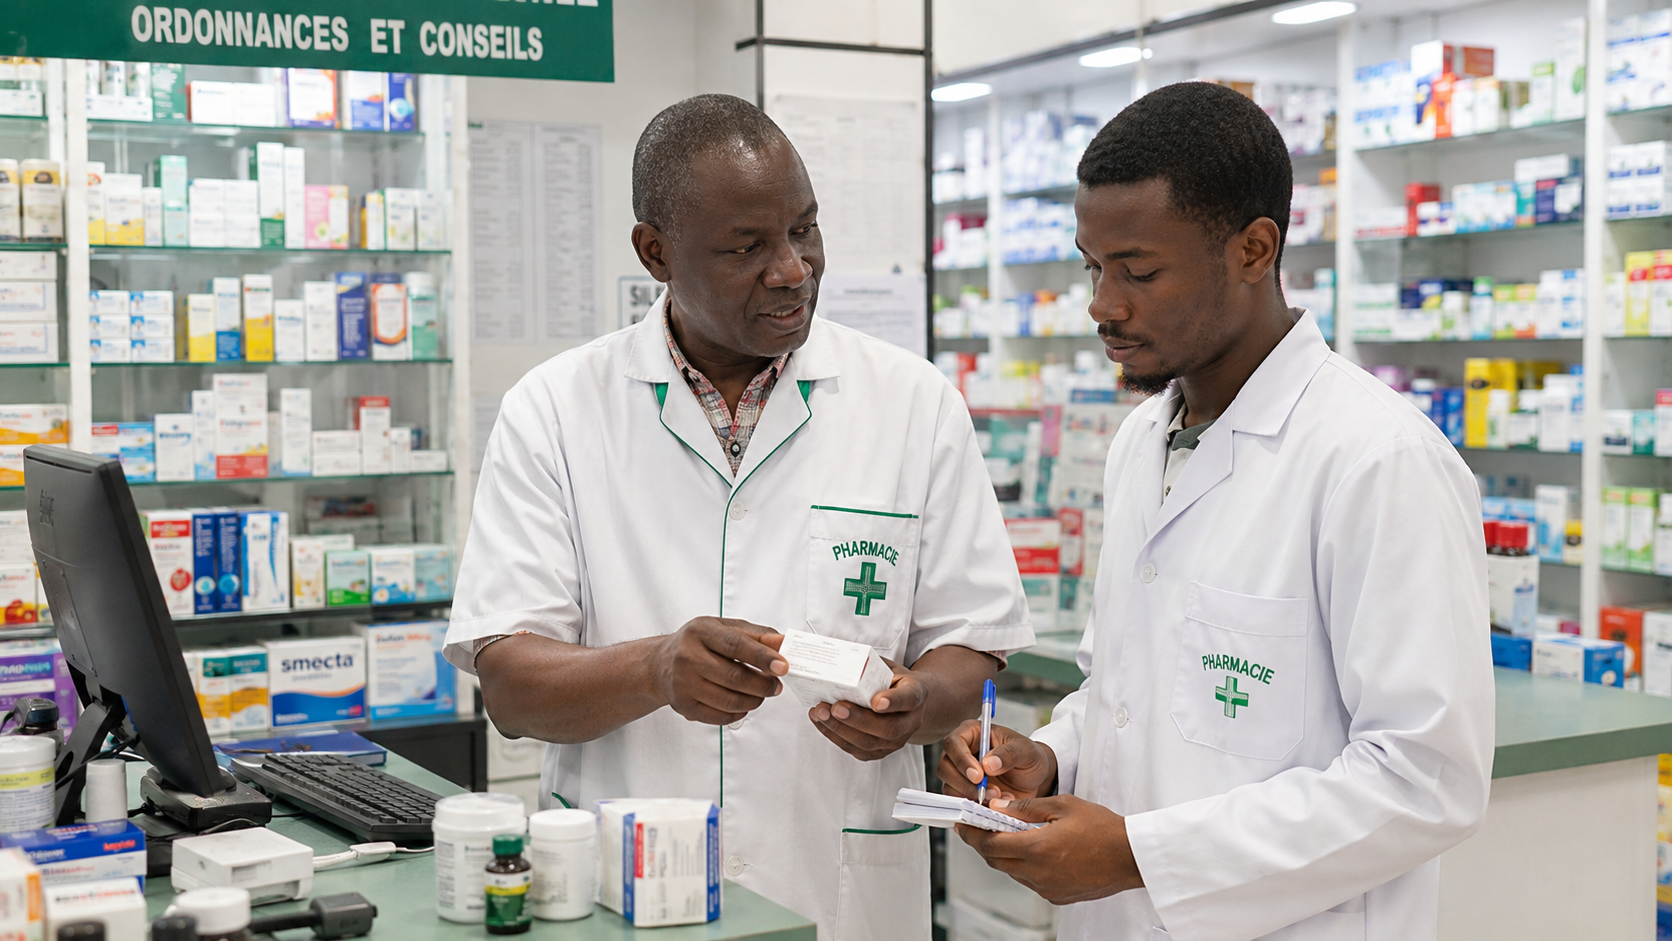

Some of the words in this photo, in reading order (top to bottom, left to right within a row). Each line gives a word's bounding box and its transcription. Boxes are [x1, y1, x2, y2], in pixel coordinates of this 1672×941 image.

[131, 5, 349, 52] ORDONNANCES
[370, 18, 405, 54] ET
[420, 21, 543, 61] CONSEILS
[832, 541, 899, 566] PHARMACIE
[281, 653, 353, 673] smecta
[1202, 653, 1275, 685] PHARMACIE
